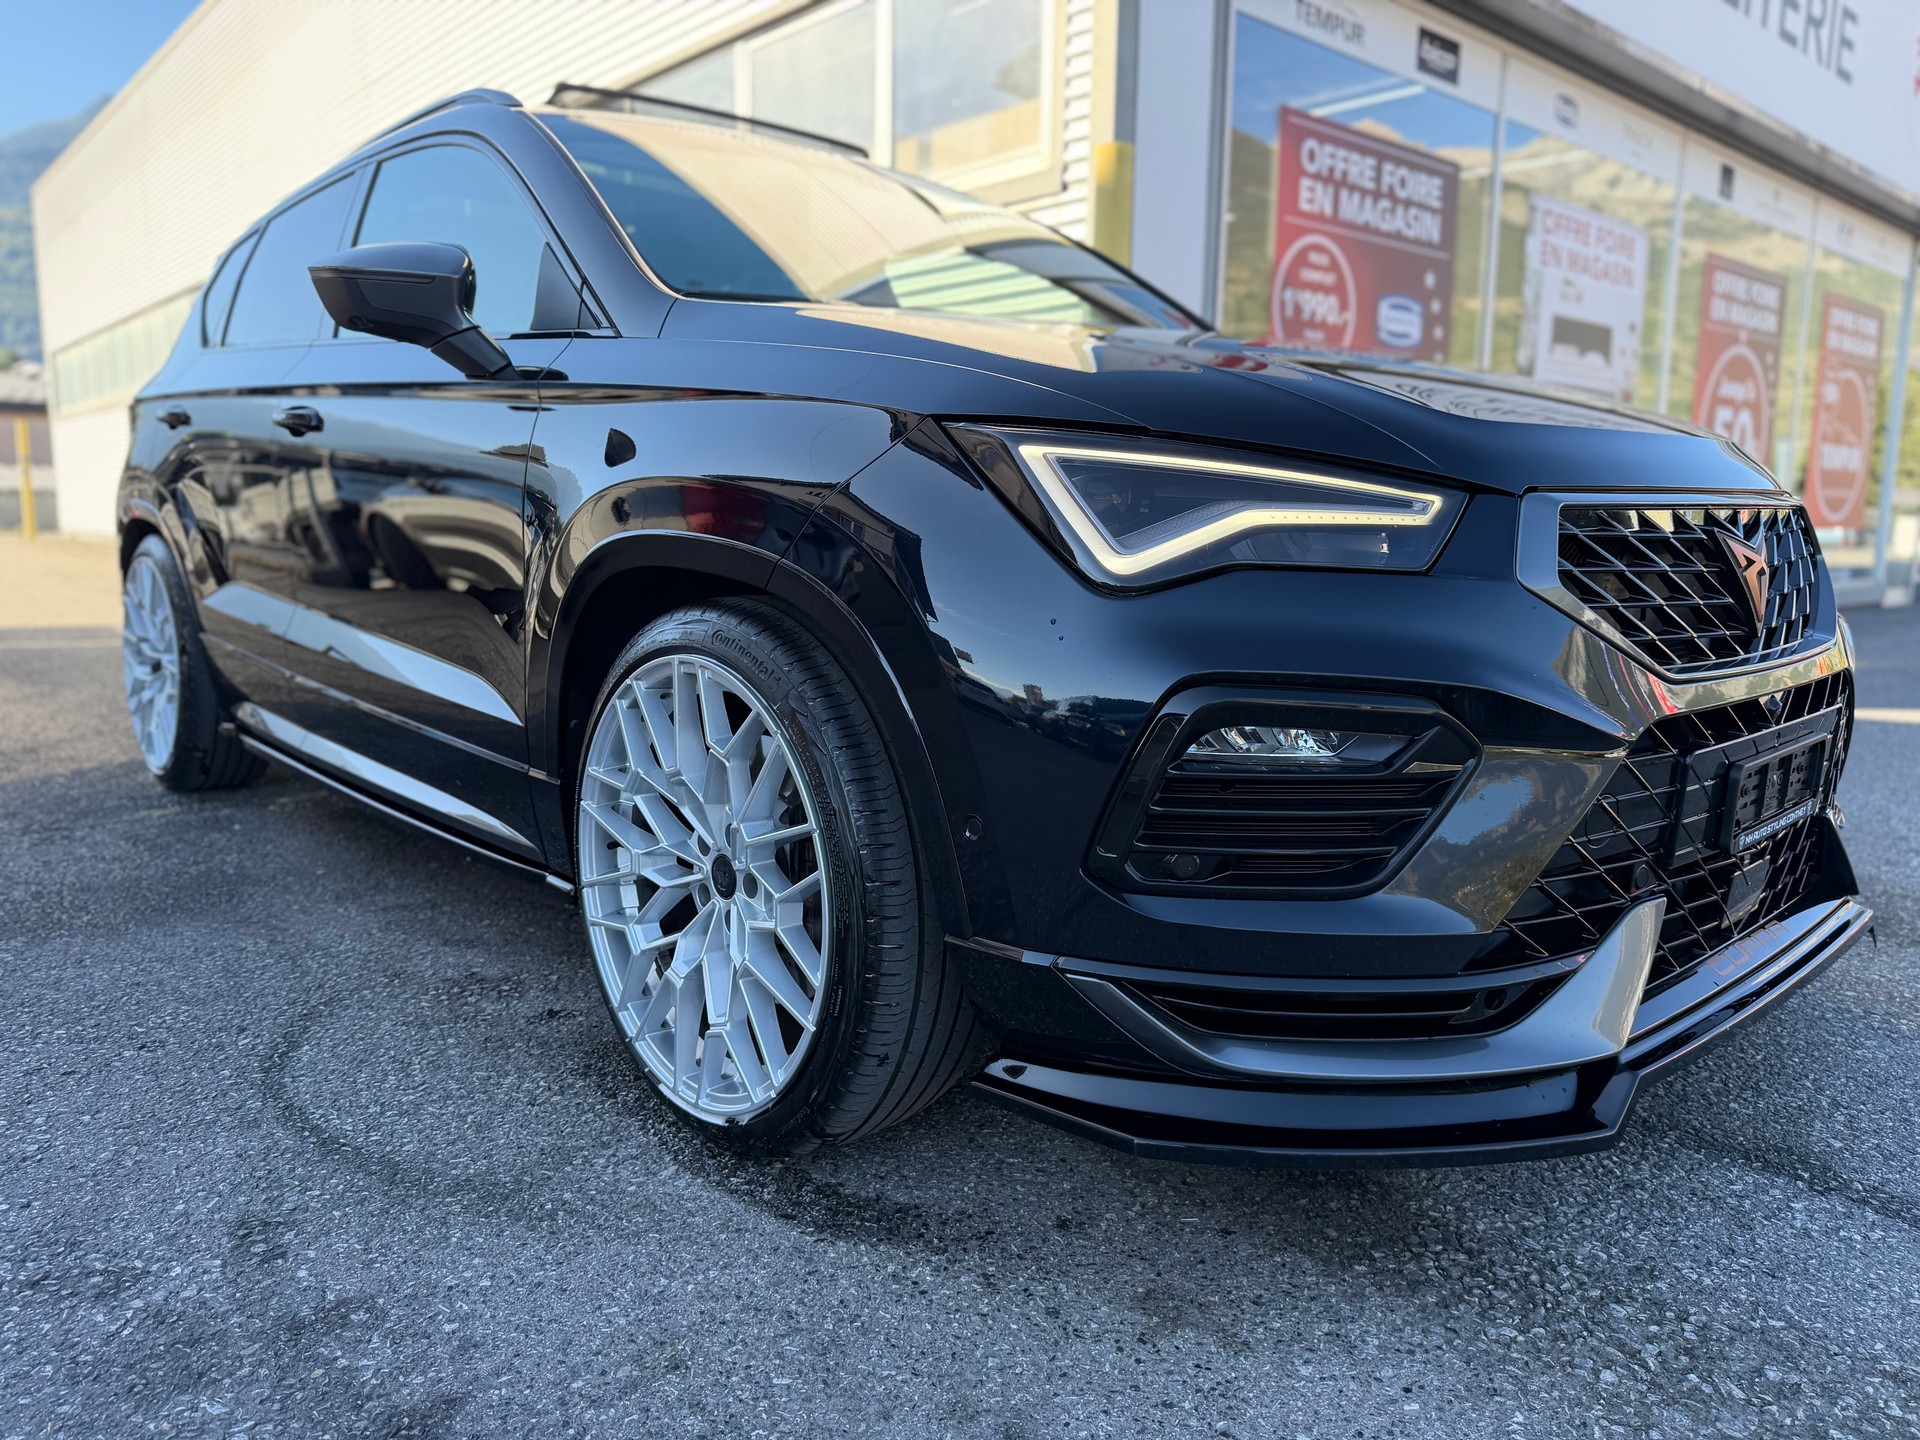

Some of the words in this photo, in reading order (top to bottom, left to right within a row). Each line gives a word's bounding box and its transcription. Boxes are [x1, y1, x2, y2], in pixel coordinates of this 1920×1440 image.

[1295, 0, 1366, 48] TEMPUR
[1301, 137, 1378, 190] OFFRE
[1381, 162, 1443, 209] FOIRE
[1298, 177, 1334, 217] EN
[1338, 188, 1442, 245] MAGASIN
[711, 629, 775, 680] Continental
[1745, 834, 1754, 845] NH
[1753, 827, 1767, 841] AUTO
[1767, 817, 1787, 833] STYLING
[1786, 806, 1807, 823] CONTHEY
[1706, 920, 1791, 976] CUPRA
